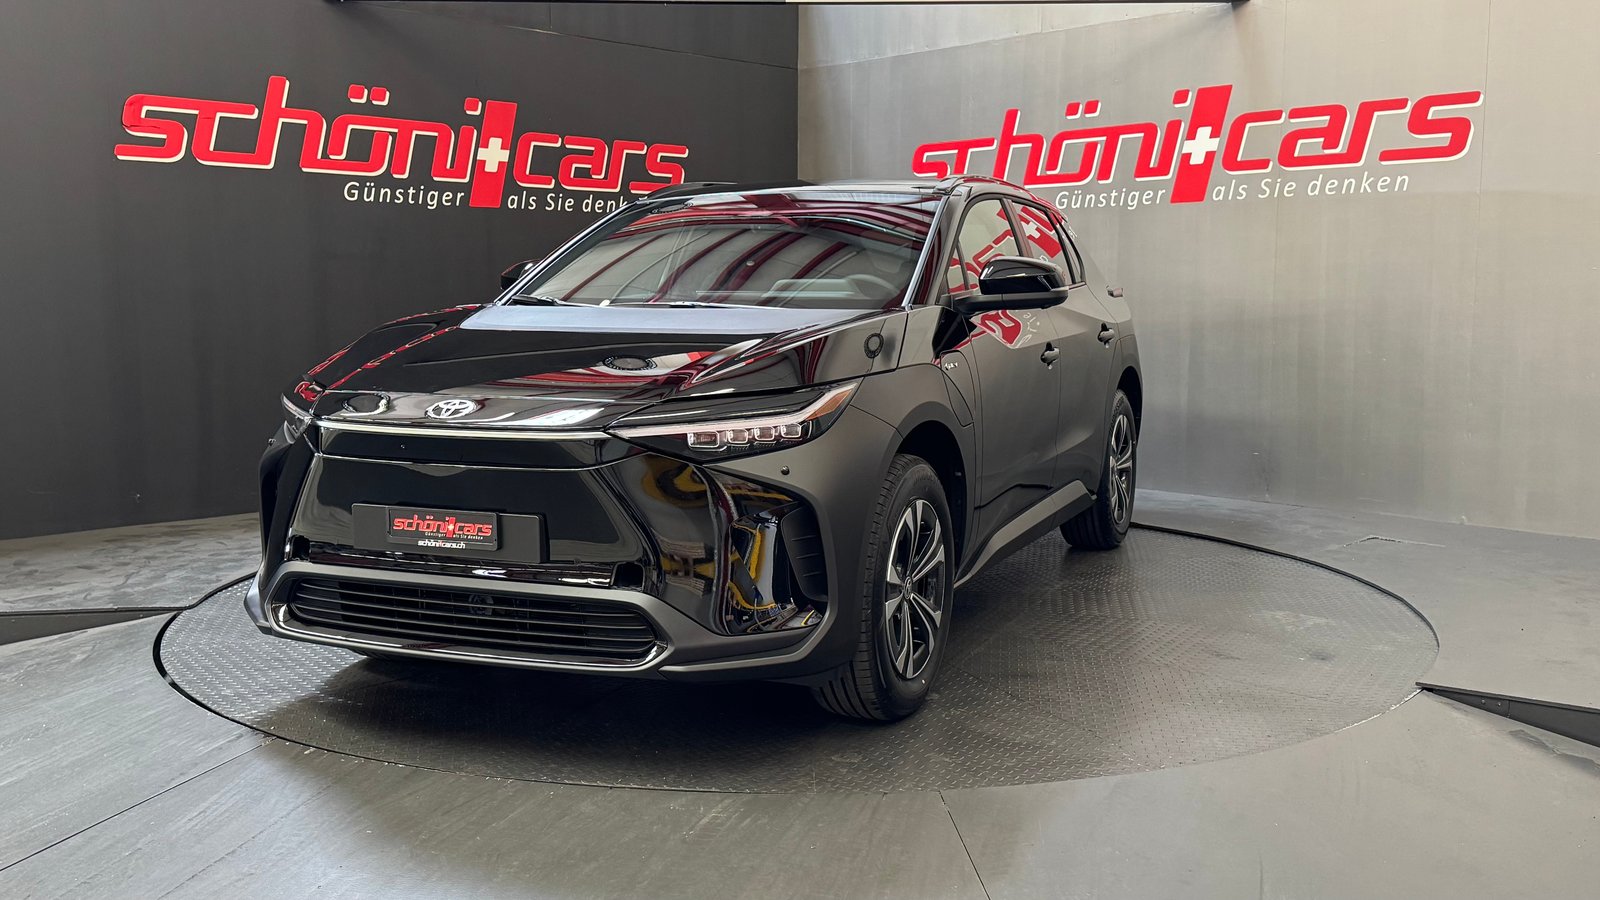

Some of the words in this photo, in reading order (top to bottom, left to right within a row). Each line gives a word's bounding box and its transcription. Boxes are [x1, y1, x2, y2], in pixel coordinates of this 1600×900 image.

[343, 181, 465, 210] Günstiger
[507, 190, 537, 210] als
[545, 193, 575, 212] Sie
[1055, 188, 1166, 210] Günstiger
[1212, 179, 1248, 201] als
[1258, 178, 1297, 199] Sie
[1307, 171, 1410, 196] denken
